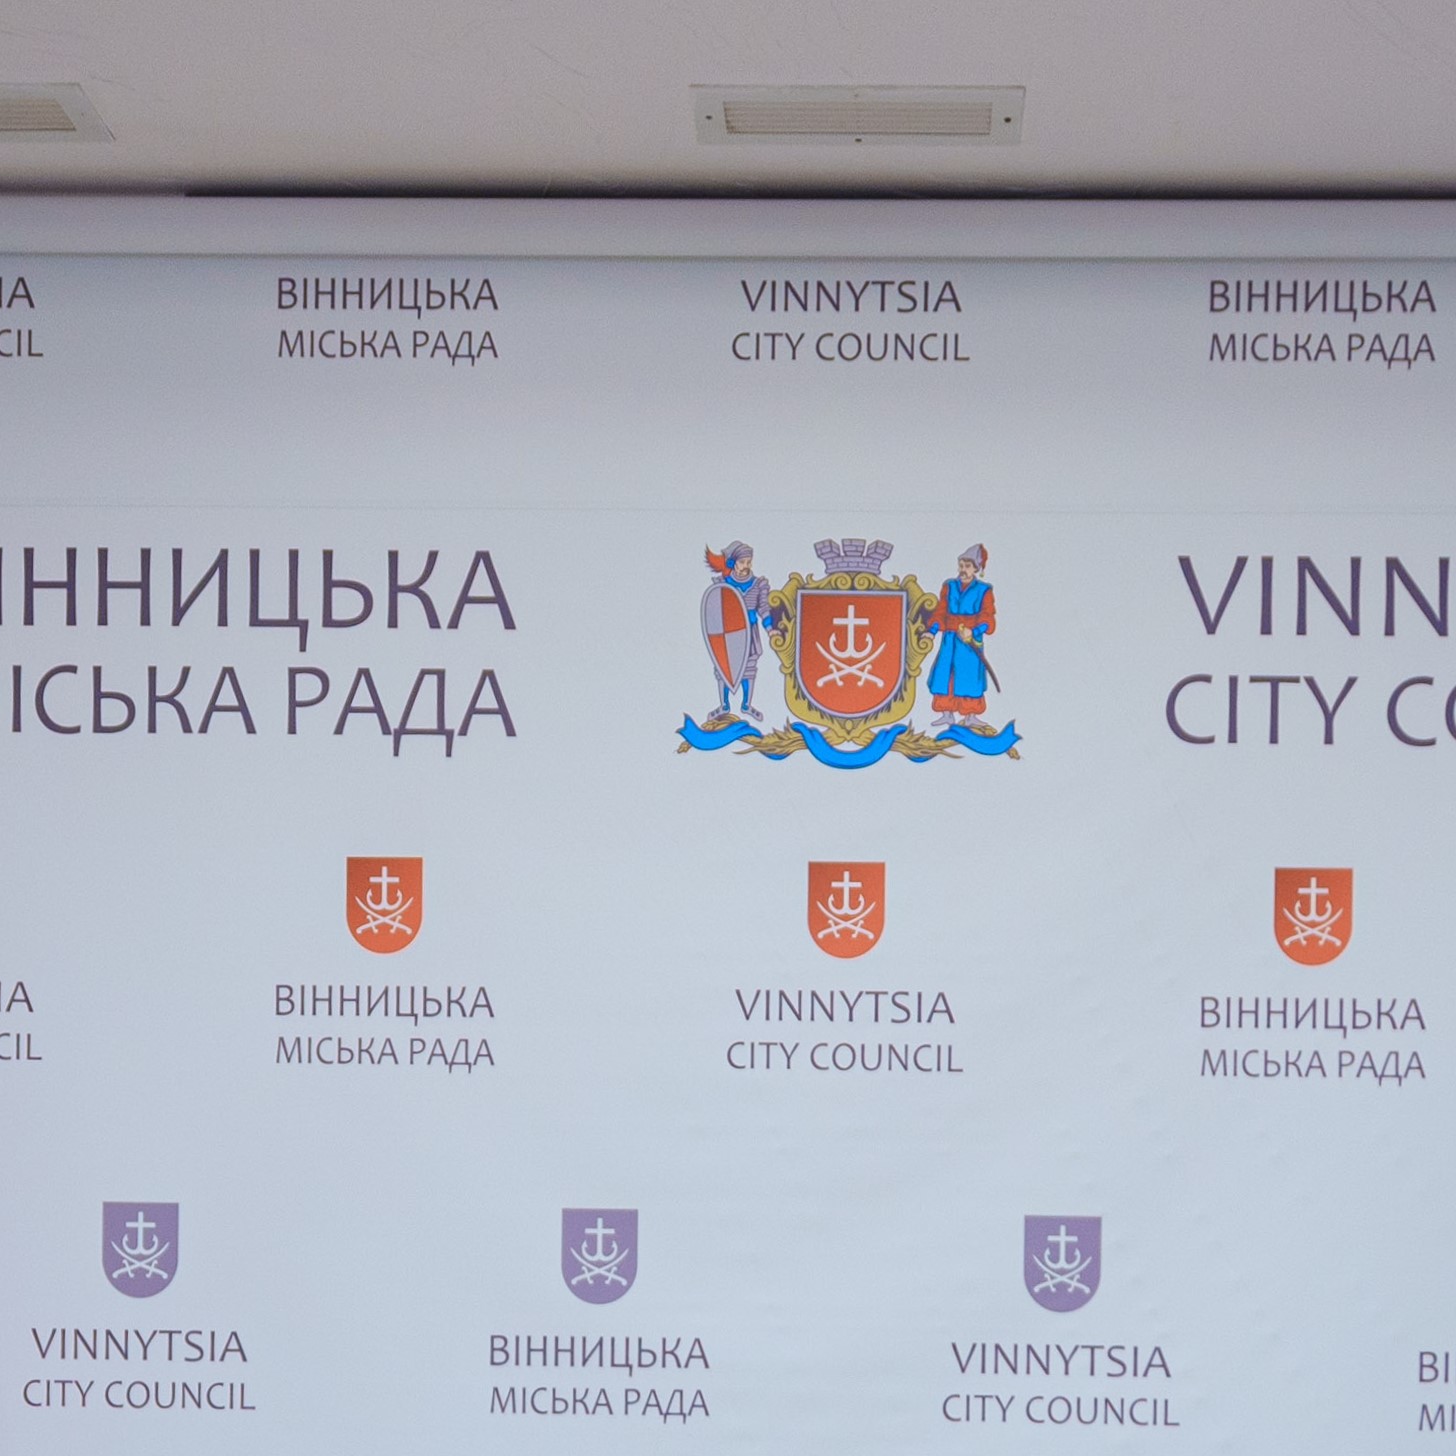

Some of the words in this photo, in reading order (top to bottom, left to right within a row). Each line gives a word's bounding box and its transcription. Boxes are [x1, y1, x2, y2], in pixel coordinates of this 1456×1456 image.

[277, 276, 499, 320] ВІННИЦЬКА
[740, 279, 962, 314] VINNYTSIA
[1209, 279, 1437, 320] ВІННИЦЬКА
[278, 329, 402, 359] МІСЬКА
[412, 330, 499, 367] РАДА
[731, 331, 806, 361] CITY
[815, 332, 970, 362] COUNCIL
[1209, 332, 1337, 363] МІСЬКА
[1347, 332, 1436, 370] РАДА
[287, 666, 517, 758] РАДА
[1165, 673, 1358, 746] CITY
[275, 984, 495, 1027] ВІННИЦЬКА
[735, 988, 955, 1024] VINNYTSIA
[1200, 996, 1427, 1039] ВІННИЦЬКА
[275, 1036, 399, 1065] МІСЬКА
[409, 1037, 495, 1074] РАДА
[726, 1041, 800, 1070] CITY
[809, 1042, 964, 1073] COUNCIL
[1200, 1048, 1327, 1078] МІСЬКА
[1337, 1050, 1426, 1087] РАДА
[31, 1327, 248, 1363] VINNYTSIA
[489, 1334, 710, 1377] ВІННИЦЬКА
[951, 1342, 1172, 1379] VINNYTSIA
[22, 1378, 95, 1408] CITY
[104, 1380, 256, 1411] COUNCIL
[490, 1386, 614, 1416] МІСЬКА
[624, 1388, 710, 1425] РАДА
[942, 1393, 1015, 1423] CITY
[1025, 1395, 1180, 1427] COUNCIL
